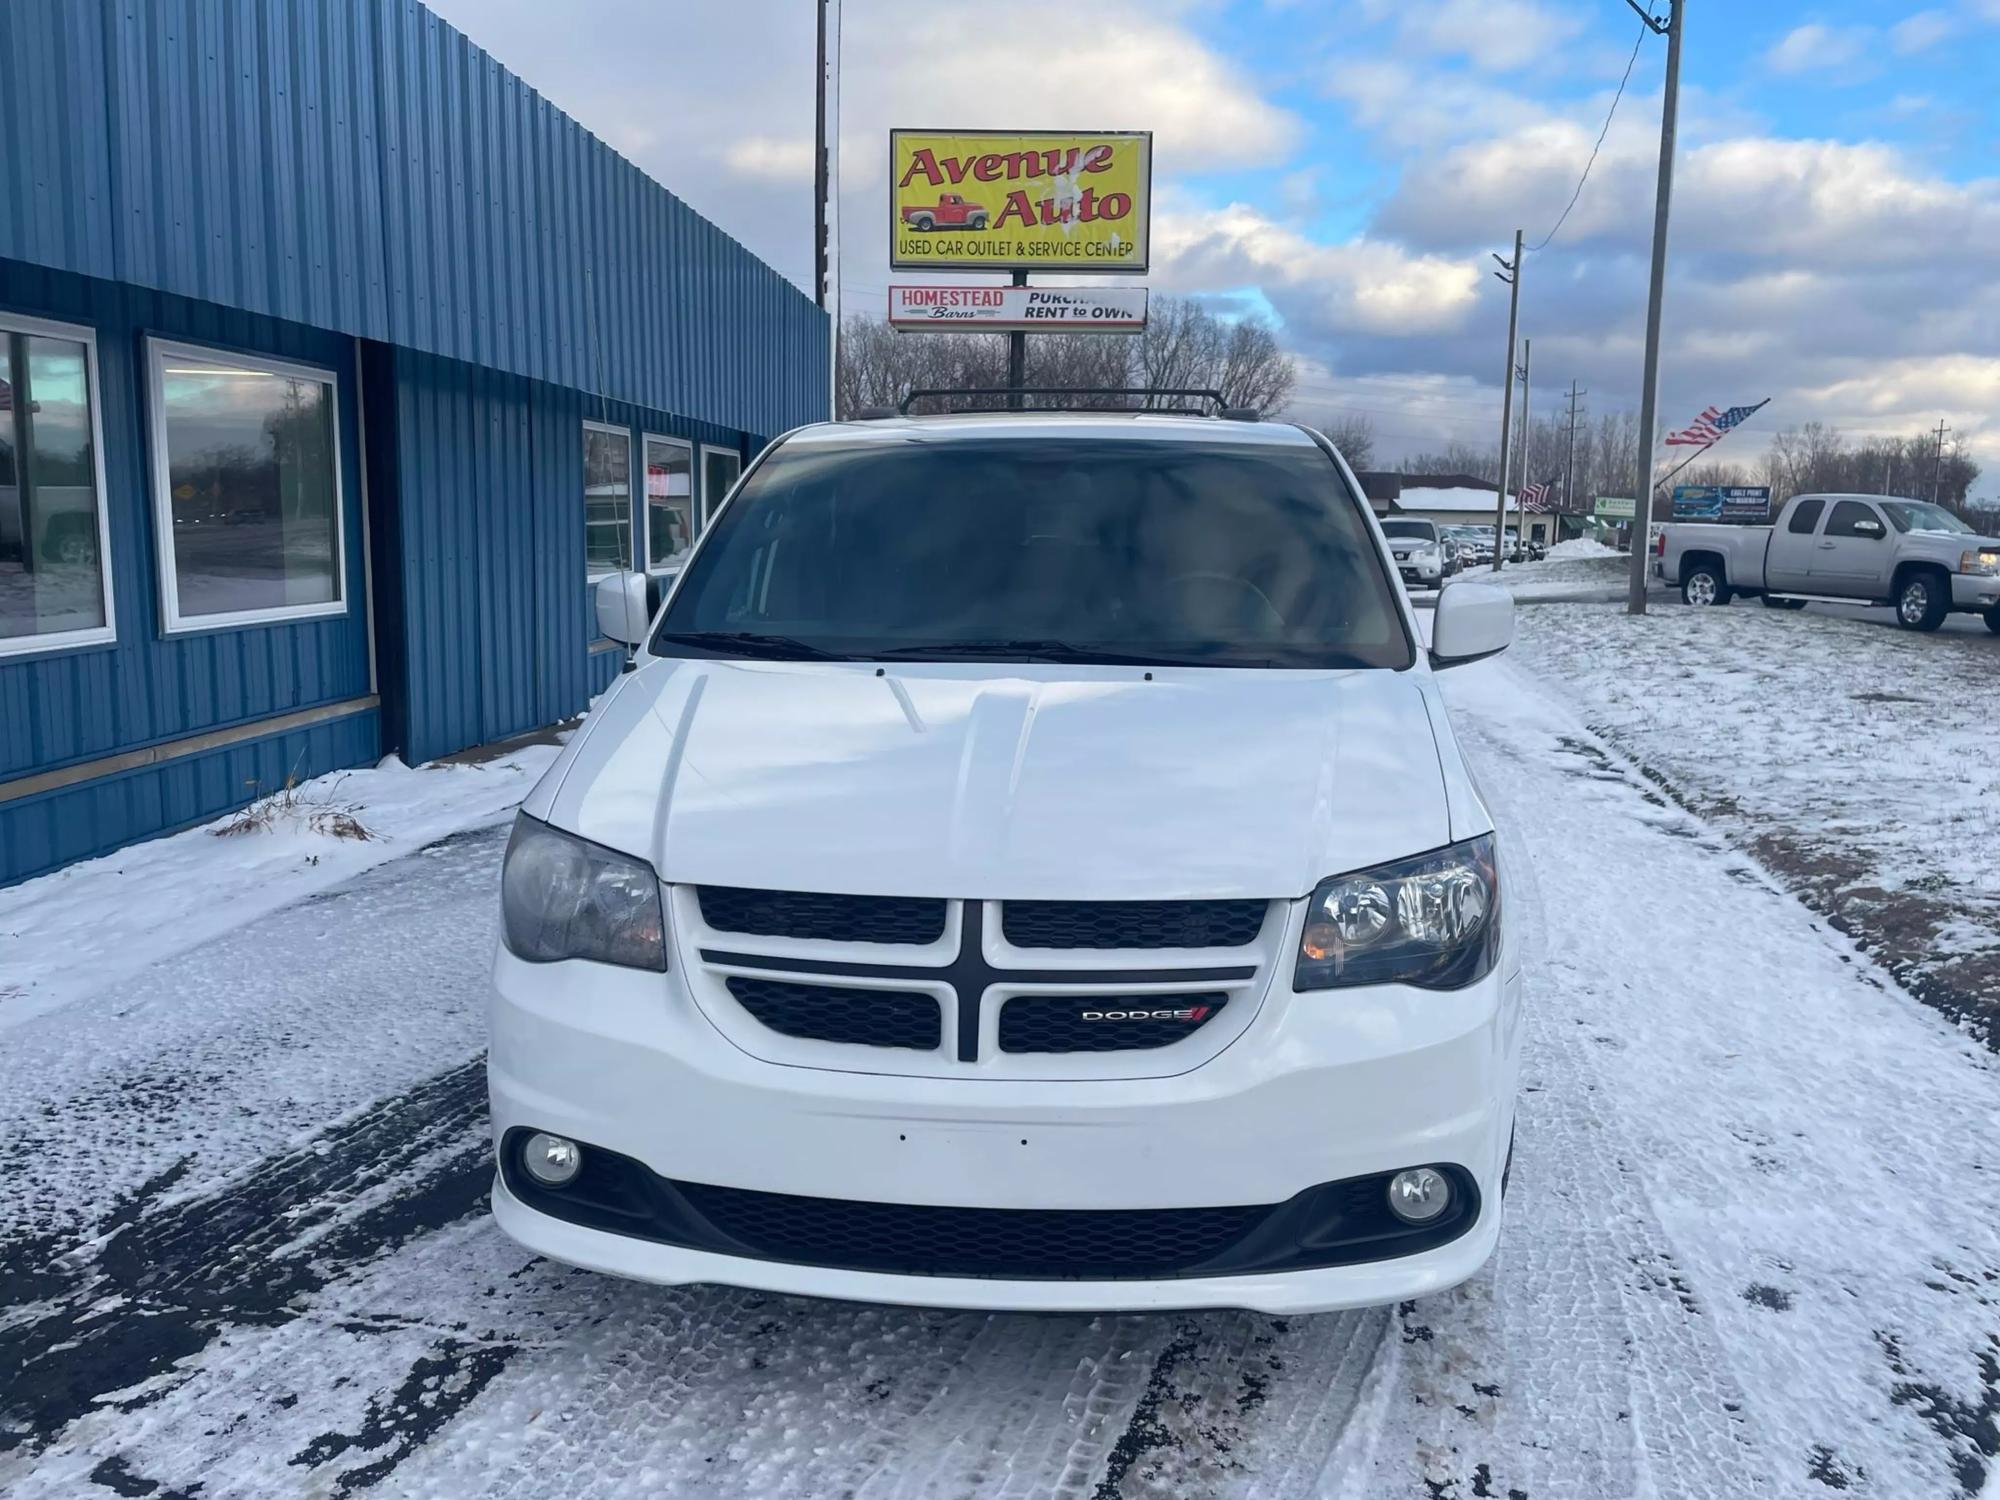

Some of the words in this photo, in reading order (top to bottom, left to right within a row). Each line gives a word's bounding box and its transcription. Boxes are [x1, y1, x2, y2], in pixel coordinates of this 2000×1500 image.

[898, 144, 1114, 187] Avenue
[992, 187, 1132, 229] Auto
[899, 240, 932, 255] USED
[935, 240, 963, 255] CAR
[966, 240, 1012, 256] OUTLET
[1016, 241, 1026, 256] &
[1028, 240, 1081, 256] SERVICE
[902, 290, 1004, 306] HOMESTEAD
[927, 306, 978, 319] Barns
[1025, 307, 1069, 318] RENT
[1073, 307, 1087, 317] to
[1082, 1009, 1193, 1021] DODGE
